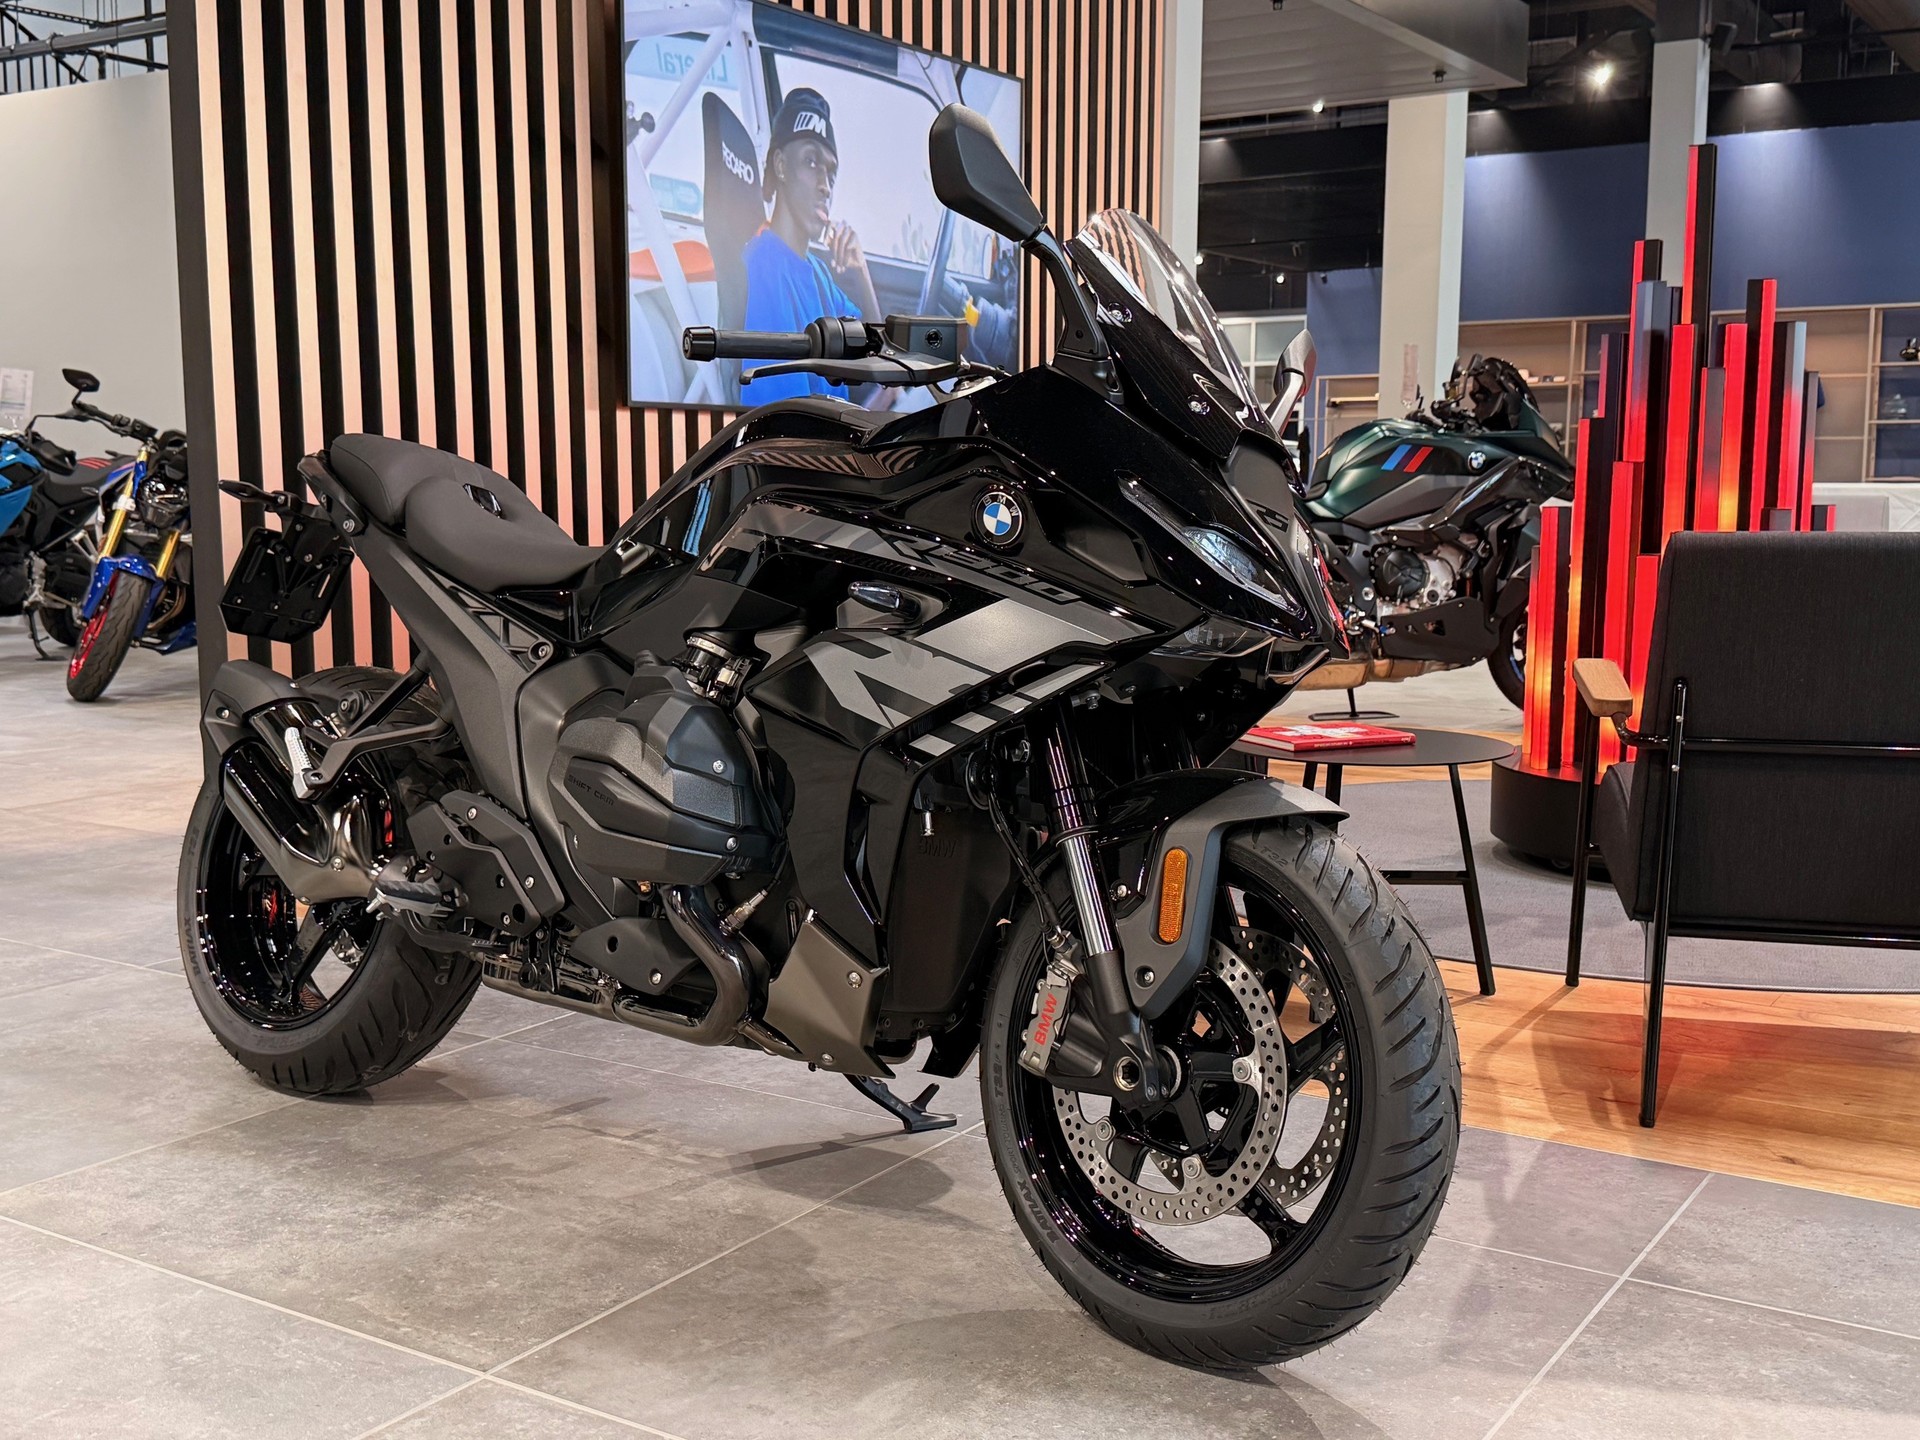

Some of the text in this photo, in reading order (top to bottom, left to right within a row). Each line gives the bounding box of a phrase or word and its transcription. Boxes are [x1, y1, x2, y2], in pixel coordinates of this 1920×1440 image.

[983, 494, 1020, 517] BMW
[567, 773, 592, 792] SHIFT
[1260, 846, 1289, 868] T32
[1033, 992, 1058, 1046] BMW
[1017, 1179, 1060, 1244] BATTLAX
